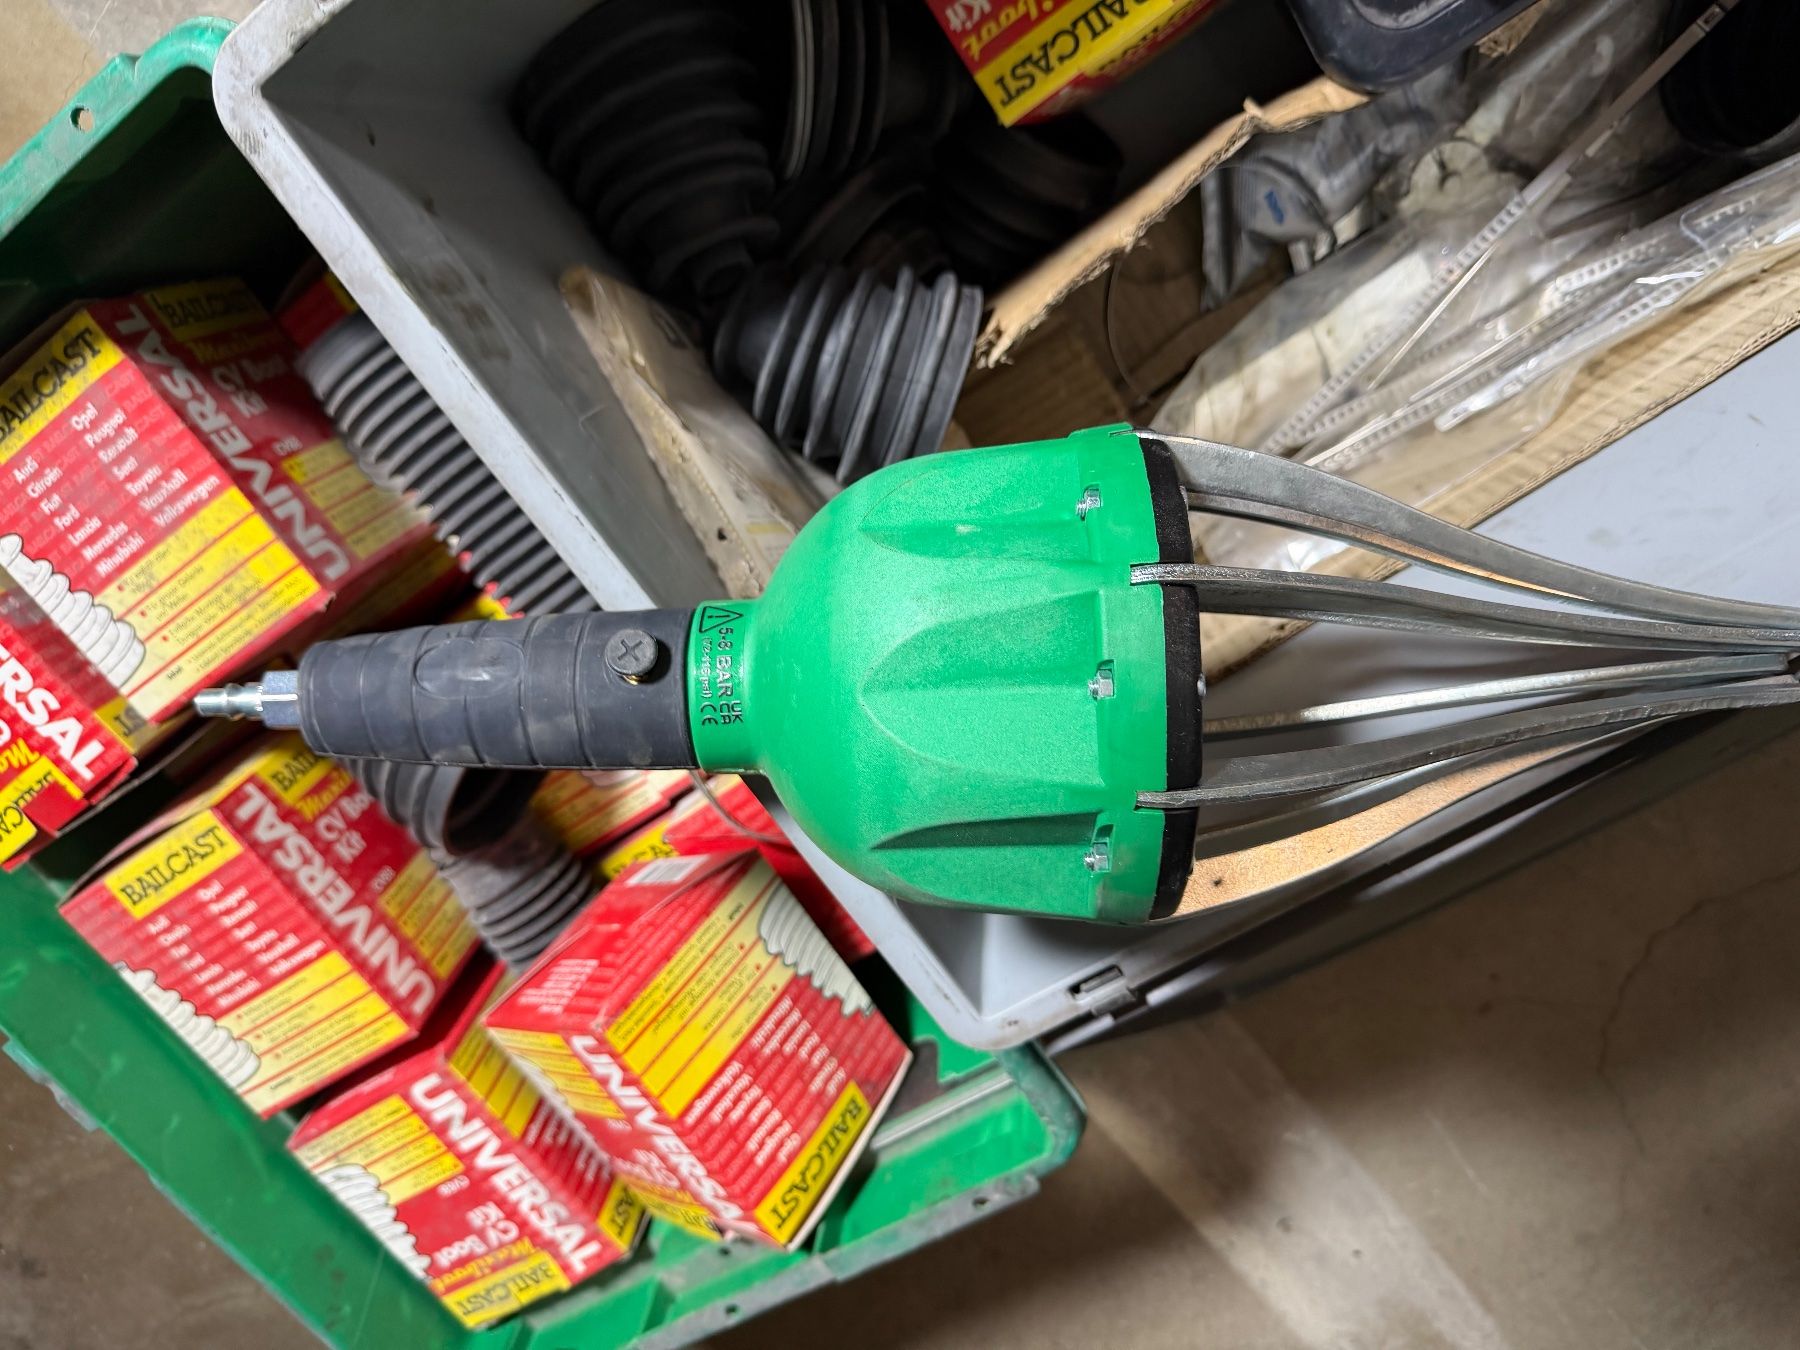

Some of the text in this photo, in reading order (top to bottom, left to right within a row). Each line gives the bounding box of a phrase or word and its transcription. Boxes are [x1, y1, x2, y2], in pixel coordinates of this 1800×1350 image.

[962, 0, 1058, 61] boot
[70, 401, 99, 431] Opel
[84, 408, 128, 448] Peugeot
[98, 426, 139, 464] Renault
[115, 303, 351, 582] UNIVERSAL
[12, 456, 39, 484] Audi
[26, 466, 63, 499] Citroën
[112, 456, 139, 481] Seat
[125, 465, 163, 496] Toyota
[40, 493, 63, 516] Fiat
[139, 468, 189, 512] Vauxhall
[153, 475, 220, 528] Volkswagen
[53, 503, 81, 532] Ford
[68, 515, 102, 547] Lancia
[82, 521, 129, 561] Mercedes
[96, 532, 146, 578] Mitsubishi
[716, 627, 734, 698] 5-8 BAR
[700, 702, 719, 726] CE
[731, 700, 745, 724] UK
[315, 807, 347, 842] CV
[120, 824, 233, 906] BAILCAST
[334, 829, 368, 863] Kit
[234, 781, 438, 1016] UNIVERSAL
[569, 1034, 744, 1221] UNIVERSA
[410, 1072, 604, 1277] UNIVERSAL
[770, 1095, 864, 1230] BAILCAST
[466, 1201, 506, 1228] Kit
[433, 1220, 520, 1269] CV Boot
